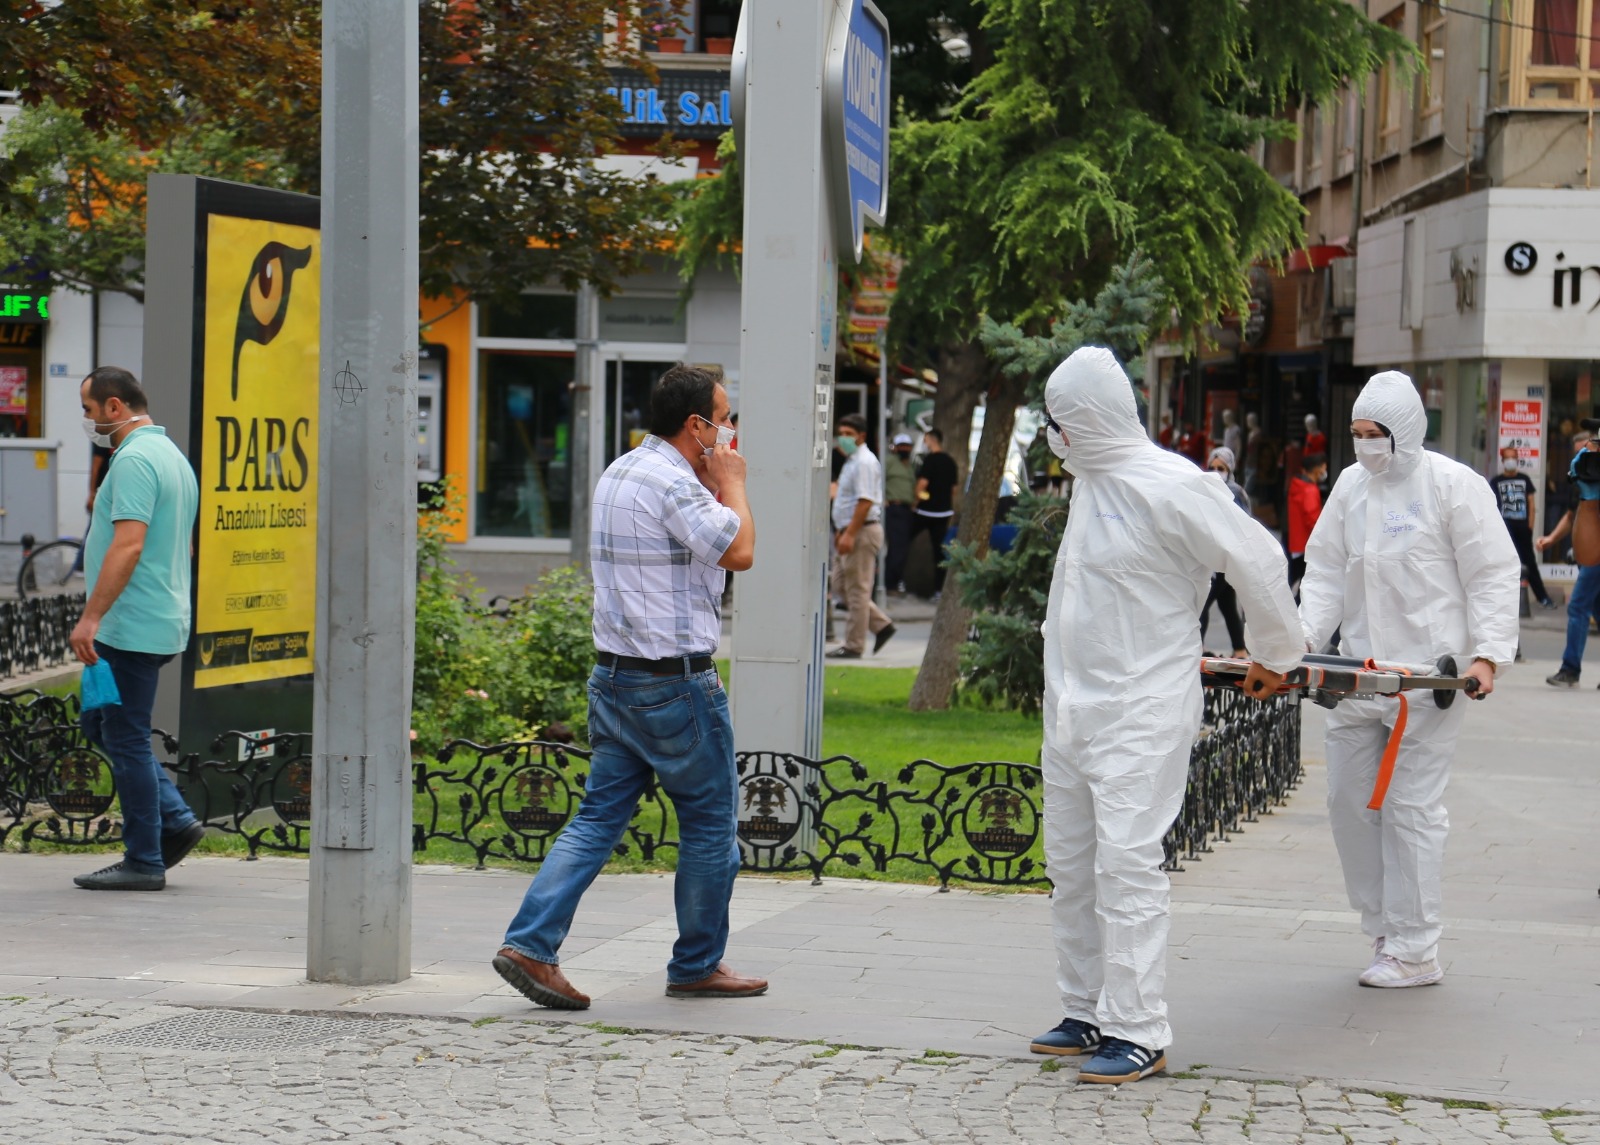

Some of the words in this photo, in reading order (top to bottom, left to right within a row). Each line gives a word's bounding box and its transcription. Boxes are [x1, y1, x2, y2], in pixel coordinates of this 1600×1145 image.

[847, 28, 883, 128] KOMEK
[214, 416, 310, 492] PARS
[214, 502, 266, 531] Anadolu
[269, 502, 307, 528] Lisesi
